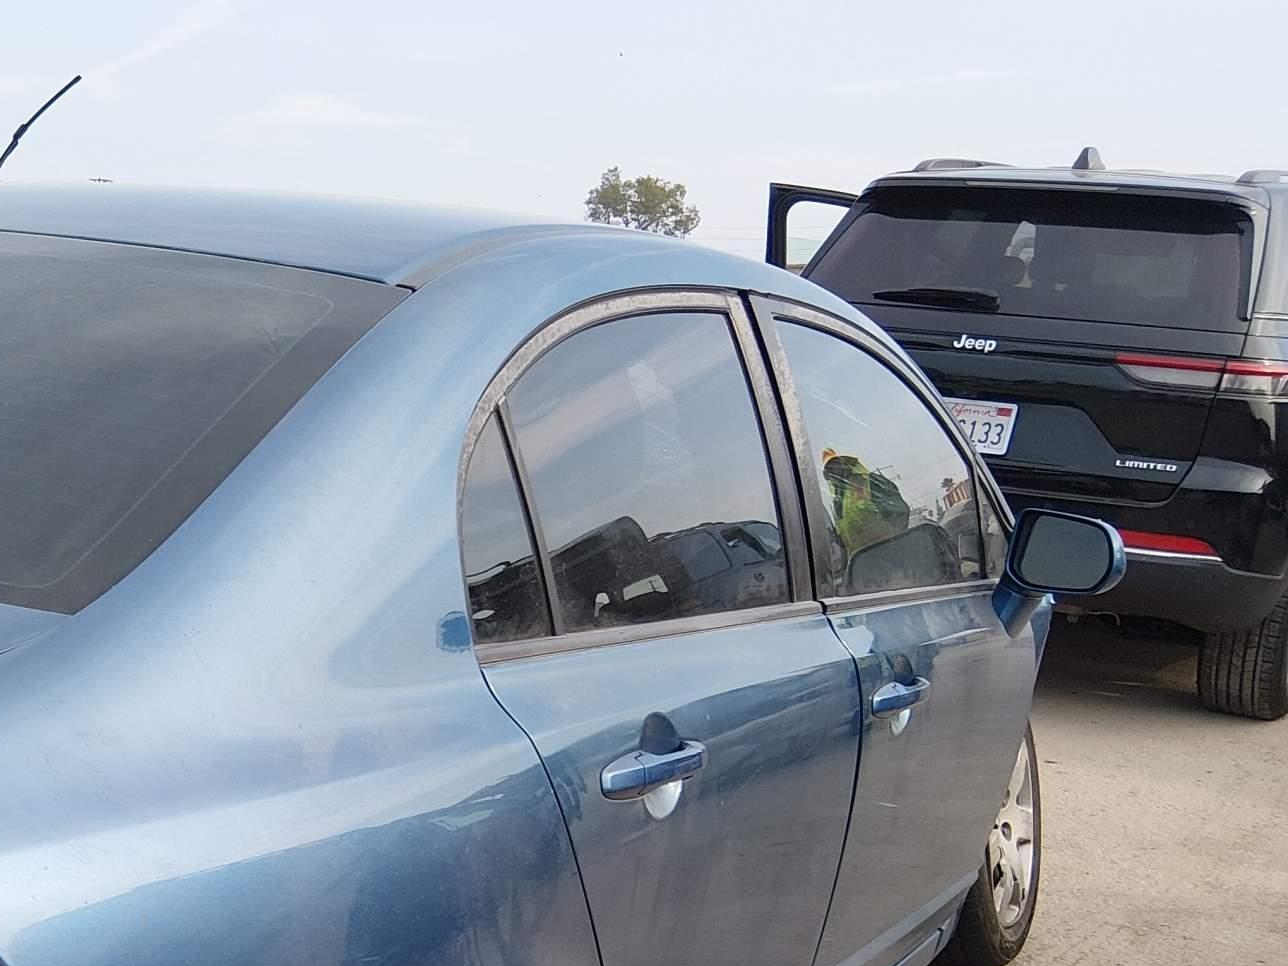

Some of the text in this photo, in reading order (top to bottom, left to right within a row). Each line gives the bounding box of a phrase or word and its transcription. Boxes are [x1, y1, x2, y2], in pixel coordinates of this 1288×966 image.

[953, 334, 997, 353] Jeep
[951, 402, 996, 417] lifornia
[958, 418, 1005, 445] 133
[1115, 459, 1178, 472] LIMITED
